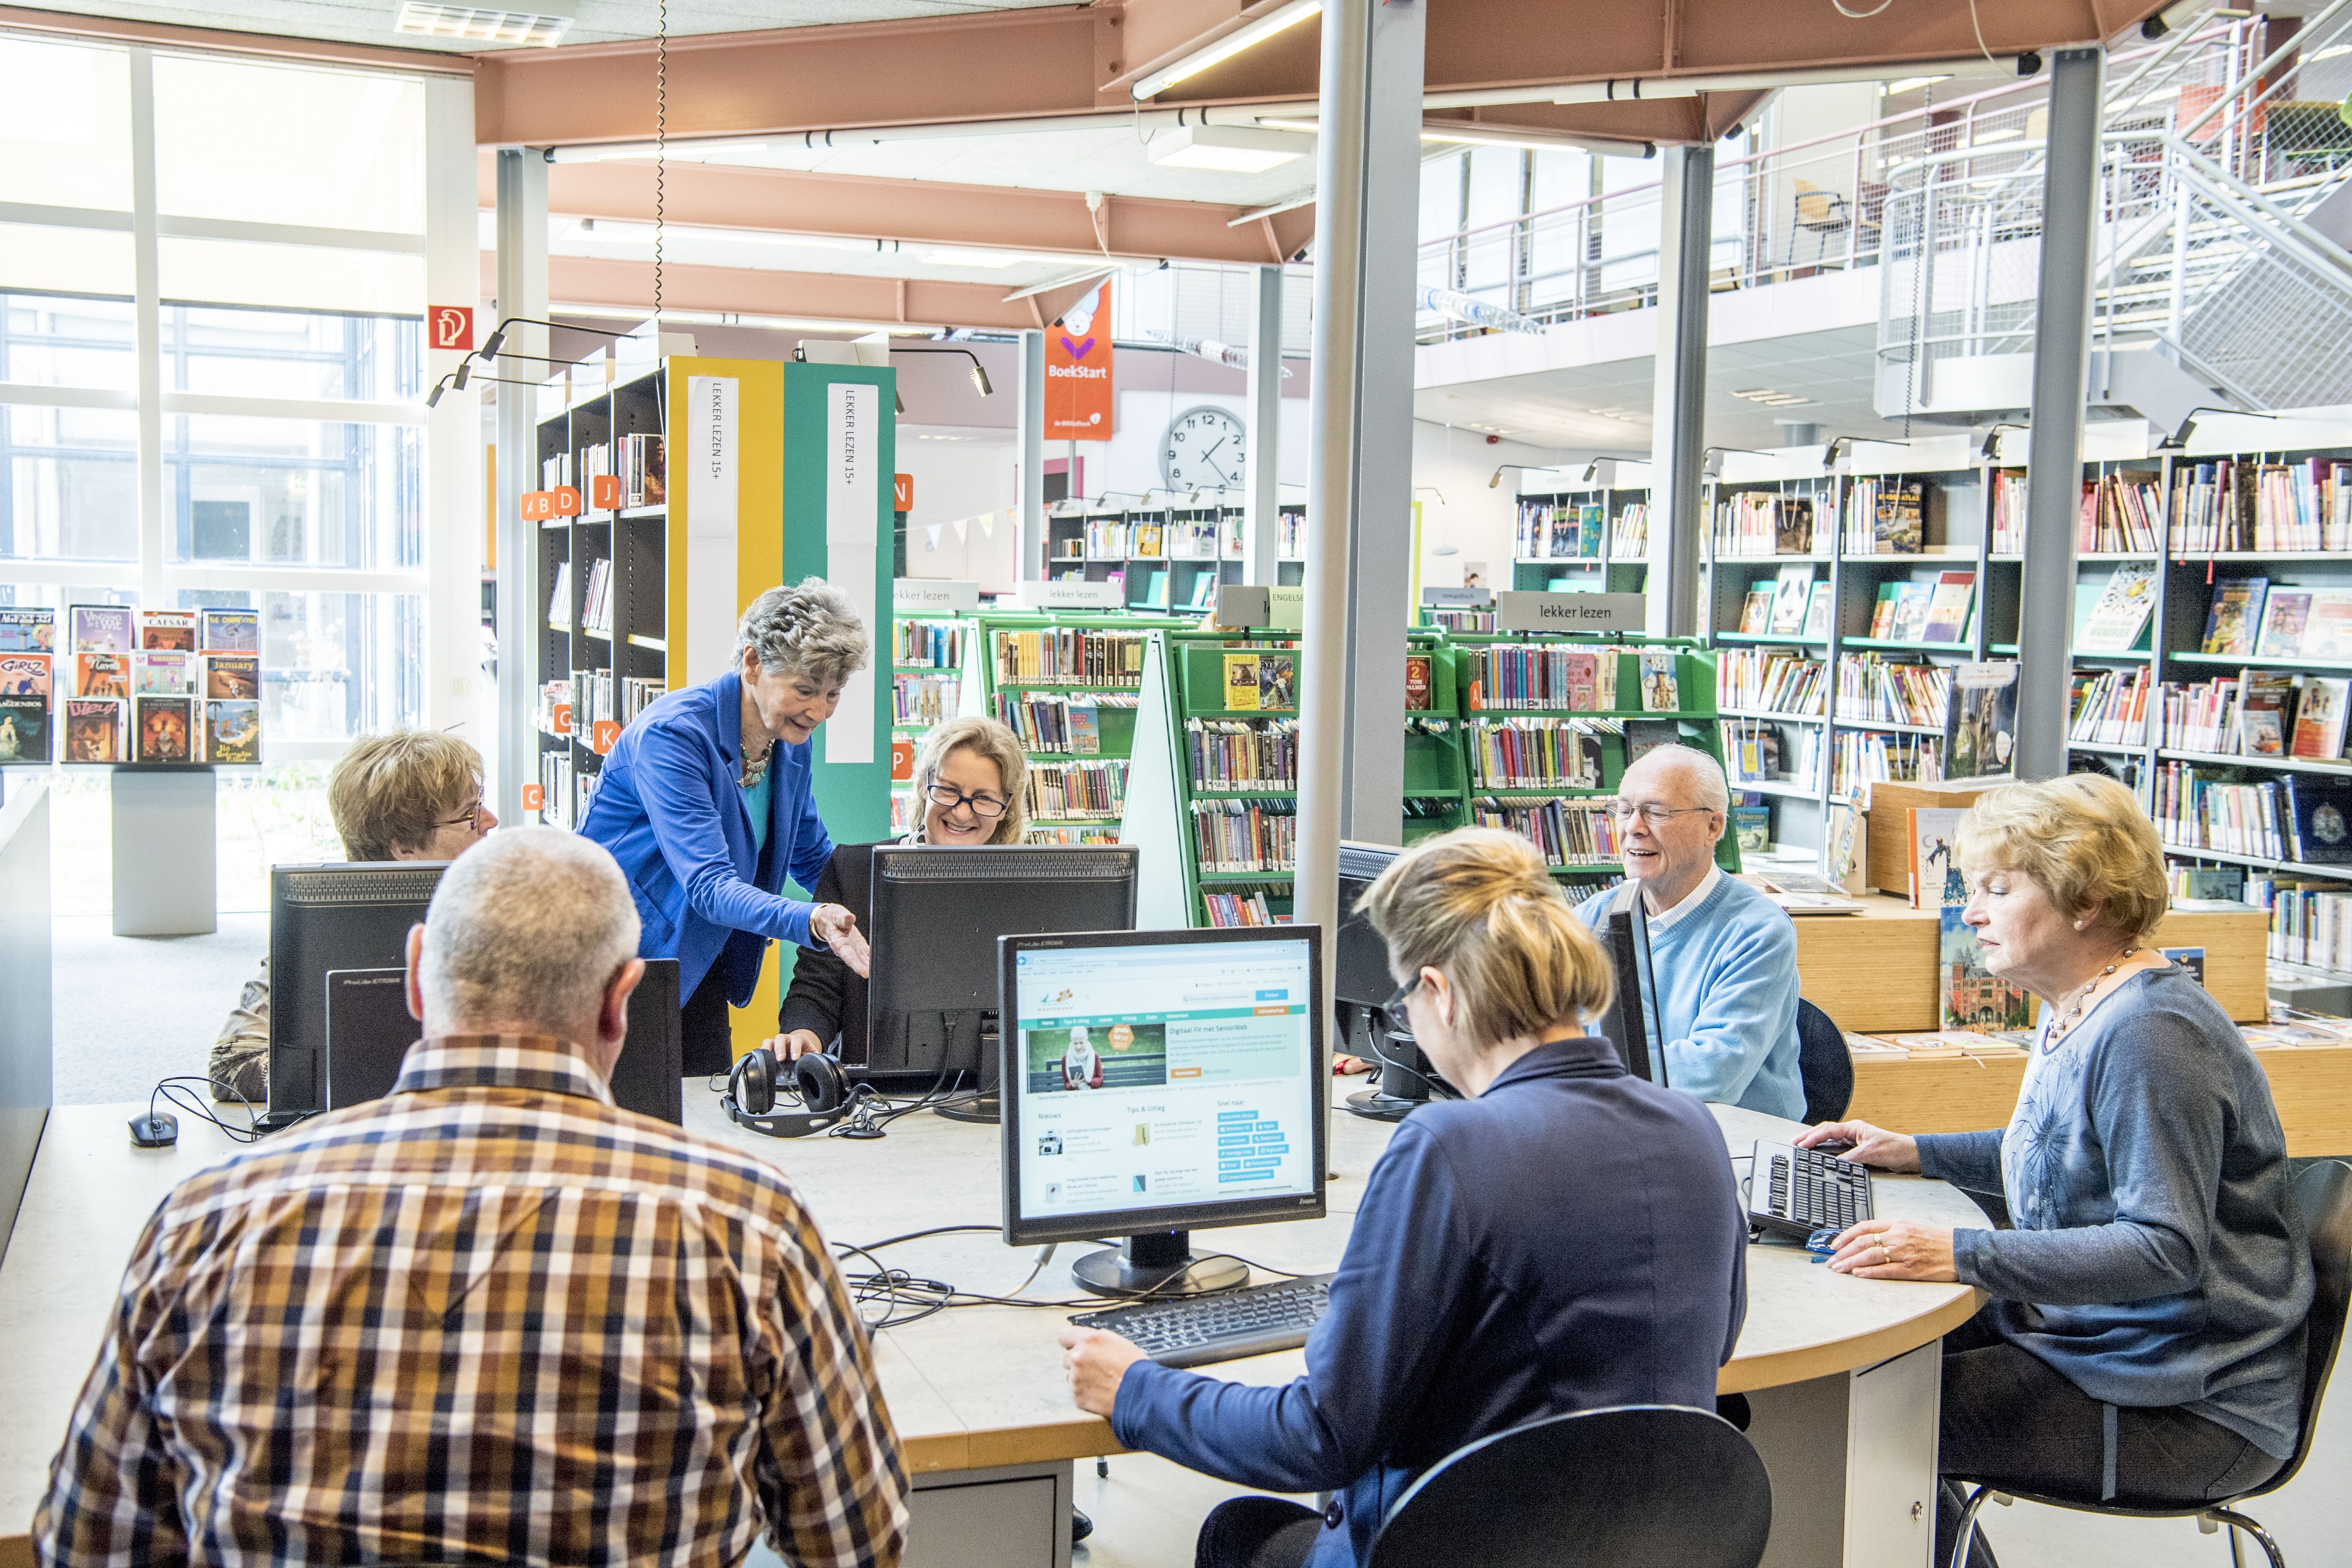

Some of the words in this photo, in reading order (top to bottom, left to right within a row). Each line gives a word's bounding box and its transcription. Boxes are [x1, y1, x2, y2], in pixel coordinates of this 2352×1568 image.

[1048, 365, 1107, 378] BoekStart
[713, 383, 721, 421] LEKKER
[846, 390, 855, 427] LEKKER
[1187, 419, 1195, 429] 11
[1202, 415, 1214, 425] 12
[1223, 422, 1226, 431] 1
[712, 425, 721, 457] LEZEN
[1174, 433, 1185, 442] 10
[1233, 435, 1241, 444] 2
[846, 432, 854, 462] LEZEN
[1168, 450, 1176, 460] 9
[1237, 453, 1245, 463] 3
[712, 461, 721, 479] 15+
[845, 466, 854, 485] 15+
[1173, 469, 1181, 478] 8
[1230, 472, 1238, 481] 4
[604, 484, 611, 501] J
[895, 483, 906, 502] N
[1218, 485, 1225, 494] 5
[539, 498, 549, 513] B
[561, 493, 572, 509] D
[894, 591, 921, 600] ekker
[923, 591, 950, 600] lezen
[1050, 590, 1074, 598] lekker
[1077, 590, 1098, 599] lezen
[1540, 605, 1576, 618] lekker
[1579, 606, 1611, 618] lezen
[215, 662, 253, 671] January
[1411, 667, 1420, 678] 2
[1473, 689, 1478, 703] A
[602, 729, 613, 746] K
[893, 752, 904, 770] P
[528, 790, 539, 804] C
